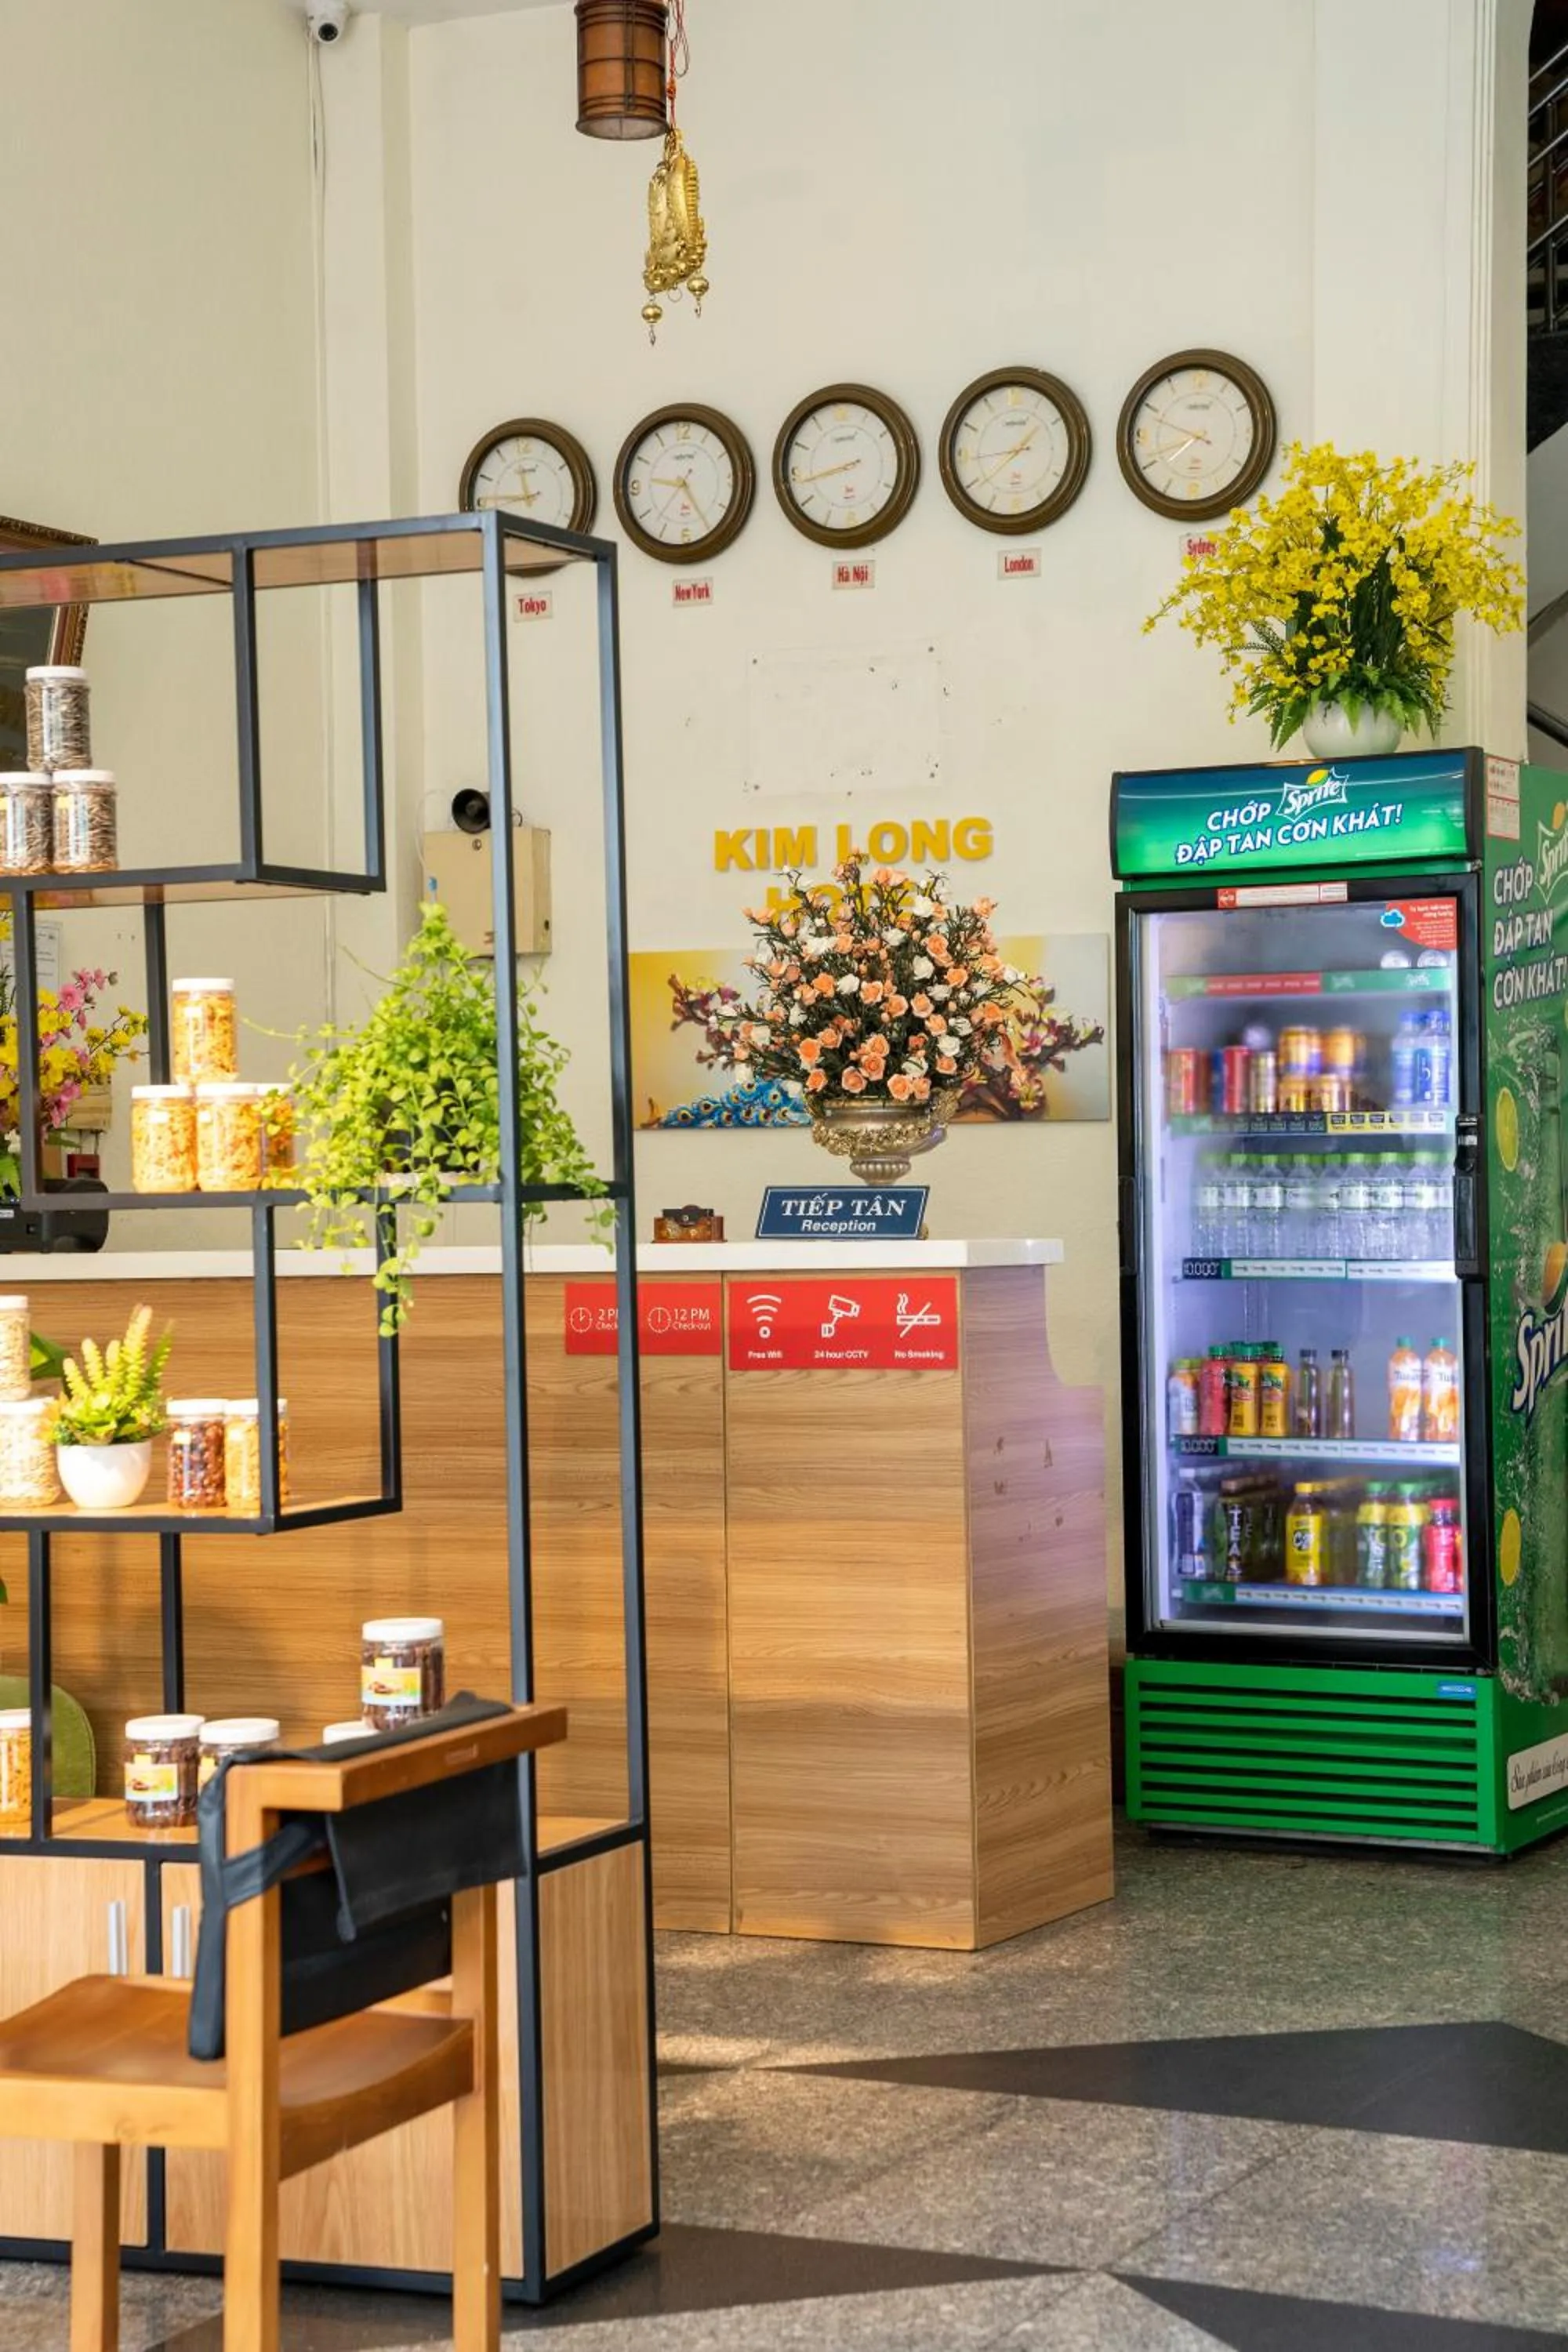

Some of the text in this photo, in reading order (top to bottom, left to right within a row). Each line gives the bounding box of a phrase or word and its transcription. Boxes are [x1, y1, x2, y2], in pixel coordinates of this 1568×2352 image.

[1004, 555, 1034, 573] London
[518, 596, 547, 615] Tokyo
[1207, 776, 1341, 831] CHỚP Sprite
[714, 816, 993, 871] KIM LONG
[1177, 803, 1403, 865] ĐẬP TAN CƠN KHÁT!
[1494, 855, 1533, 905] CHỚP
[1494, 909, 1523, 961] ĐẬP
[1525, 909, 1553, 948] TAN
[1494, 949, 1567, 1008] CƠN KHÁT!
[782, 1192, 907, 1216] TIẾP TÂN
[800, 1218, 877, 1233] Reception
[598, 1308, 619, 1321] 2 P
[673, 1307, 710, 1321] 12 PM
[673, 1321, 711, 1331] Check-out
[748, 1350, 766, 1359] Free
[814, 1350, 869, 1359] 24 hour CCTV
[894, 1350, 945, 1360] No Smoking
[1513, 1294, 1568, 1415] Spri
